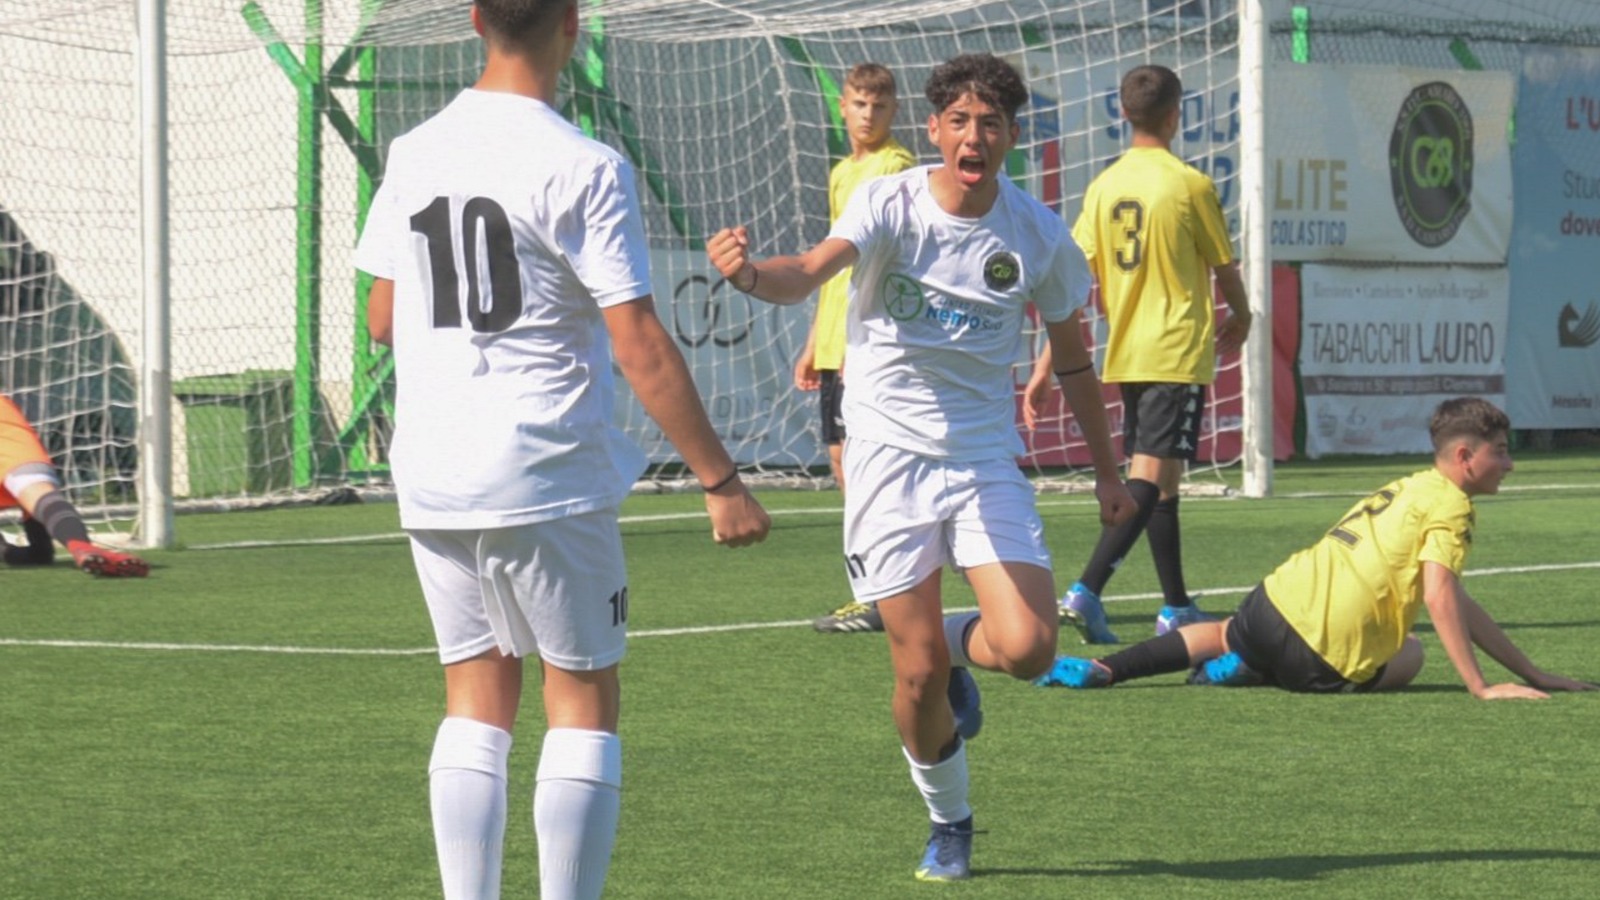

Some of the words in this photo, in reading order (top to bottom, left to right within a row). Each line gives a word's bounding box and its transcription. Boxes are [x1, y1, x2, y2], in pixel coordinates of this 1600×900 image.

[1274, 158, 1348, 211] LITE
[1563, 169, 1600, 199] Stu
[1112, 197, 1145, 272] 3
[1271, 220, 1347, 246] COLASTICO
[410, 196, 522, 334] 10
[1309, 322, 1411, 364] TABACCHI
[1417, 322, 1495, 364] LAURO
[1328, 489, 1397, 550] 2
